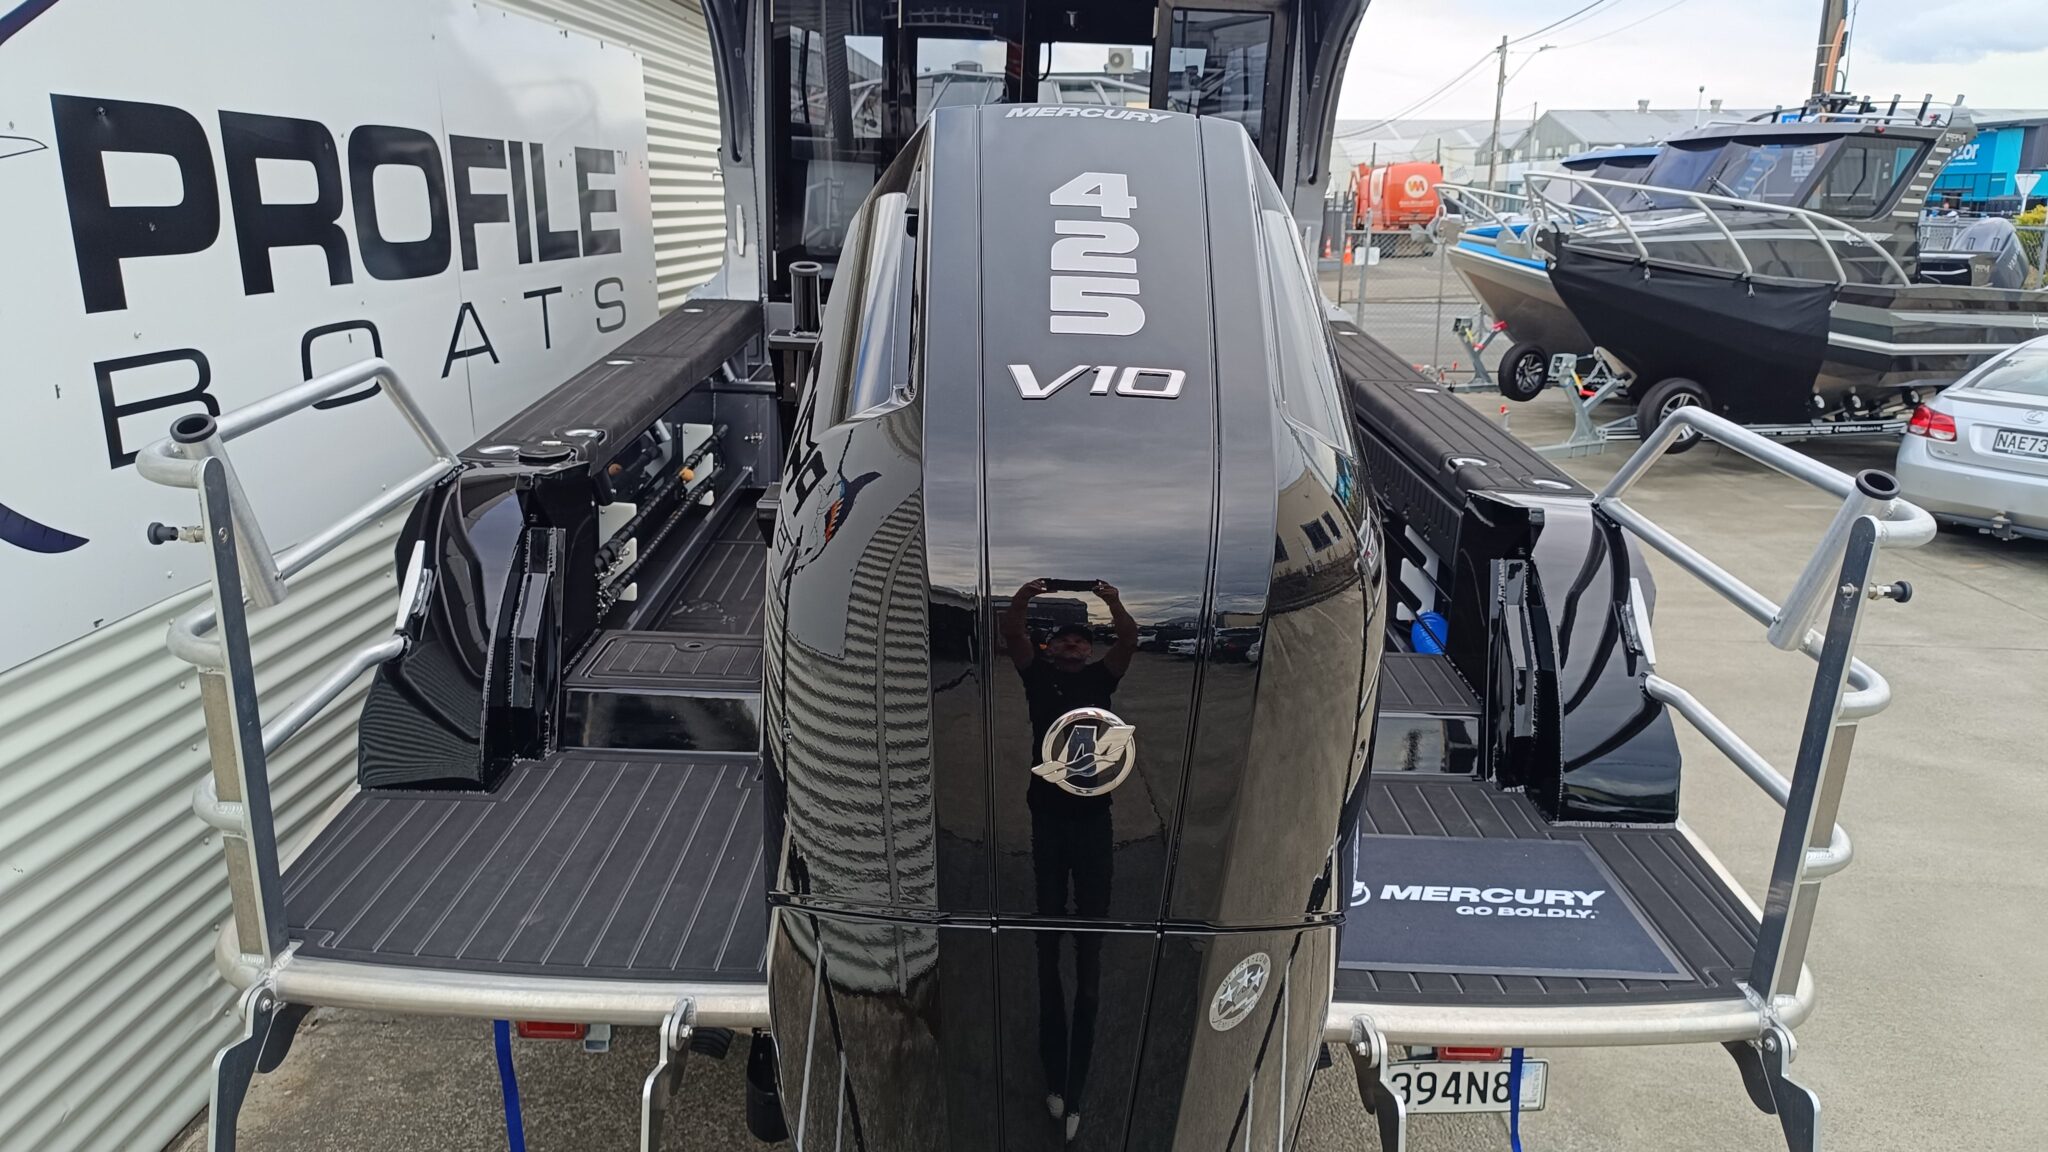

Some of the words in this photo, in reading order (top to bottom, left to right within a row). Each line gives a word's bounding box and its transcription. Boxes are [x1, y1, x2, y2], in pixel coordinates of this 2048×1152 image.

[1005, 106, 1174, 124] MERCURY
[50, 93, 622, 314] PROFILE
[1050, 171, 1146, 336] 425
[94, 276, 627, 469] BOATS
[1007, 364, 1186, 399] V10
[1997, 433, 2048, 453] NAE73
[1380, 884, 1606, 906] MERCURY
[1456, 906, 1493, 916] GO
[1497, 907, 1596, 919] BOLDLY.
[1391, 1071, 1512, 1105] 394N8
